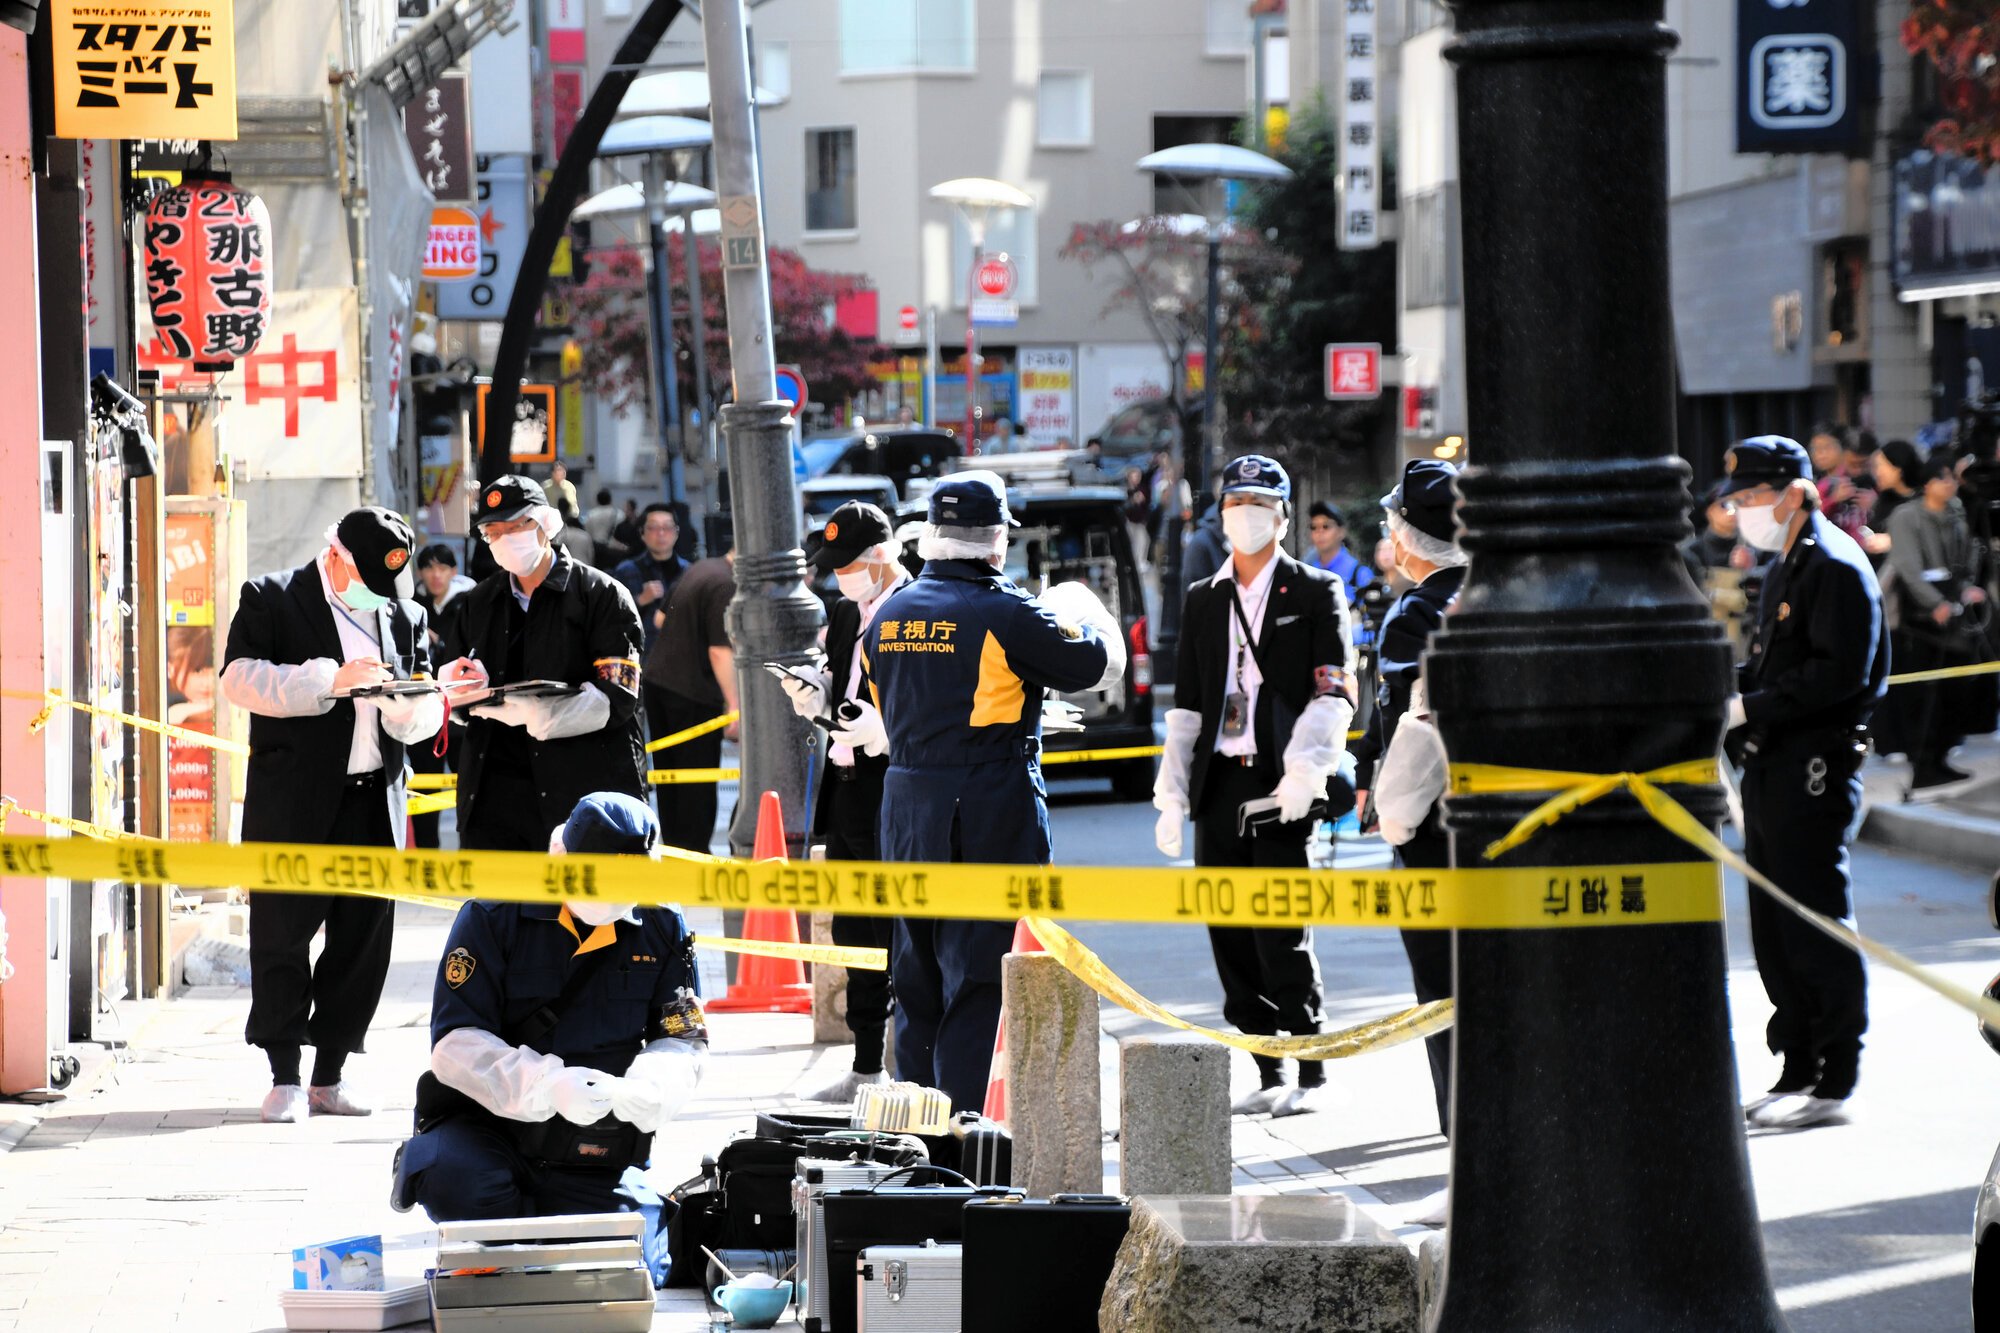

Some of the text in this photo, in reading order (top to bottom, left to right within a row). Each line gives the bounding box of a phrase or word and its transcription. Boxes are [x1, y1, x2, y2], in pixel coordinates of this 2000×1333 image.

[73, 23, 212, 52] スタンド
[124, 56, 167, 74] バイ
[76, 61, 214, 109] ミート
[423, 86, 452, 191] まぜそば
[427, 229, 476, 242] URGER
[731, 238, 755, 263] 14
[203, 223, 265, 357] 那古野
[1335, 352, 1372, 391] 足
[878, 620, 957, 641] 警視庁
[878, 641, 955, 654] INVESTIGATION
[262, 852, 310, 886] OUT
[322, 855, 394, 888] KEEP
[698, 867, 751, 903] OUT
[764, 869, 842, 905] KEEP
[1177, 877, 1235, 916] OUT
[1251, 877, 1335, 917] KEEP
[1352, 878, 1437, 918] 立入禁止
[1542, 875, 1648, 916] 警視庁
